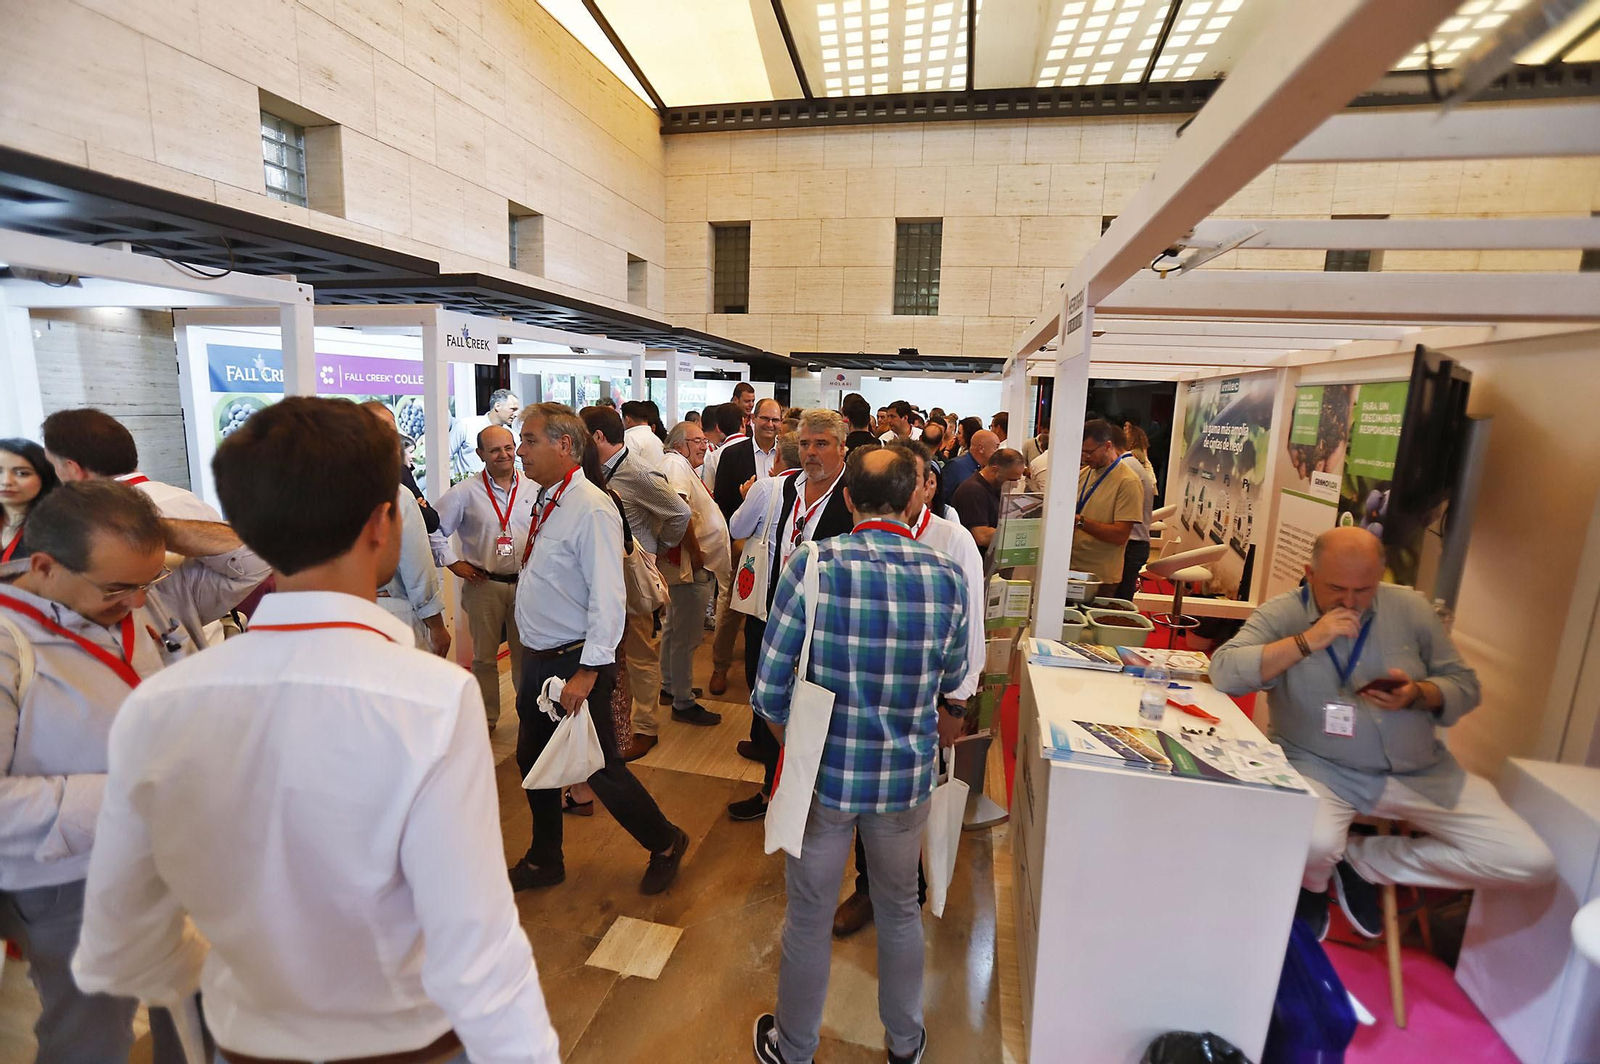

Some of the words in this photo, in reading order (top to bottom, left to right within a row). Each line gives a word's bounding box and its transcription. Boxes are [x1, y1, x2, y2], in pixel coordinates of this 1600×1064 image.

[446, 334, 464, 348] FALL
[465, 336, 490, 351] CREEK
[225, 365, 259, 382] FALL
[344, 372, 363, 382] FALL
[394, 373, 424, 385] COLLE
[1362, 402, 1377, 411] PARA
[1379, 402, 1390, 411] UN
[1361, 413, 1402, 424] CRECIMIENTO
[1208, 424, 1221, 437] gama
[1221, 422, 1231, 435] más
[1231, 422, 1249, 438] amplia
[1358, 424, 1402, 436] RESPONSABLE
[1203, 436, 1209, 448] de
[1222, 438, 1229, 451] de
